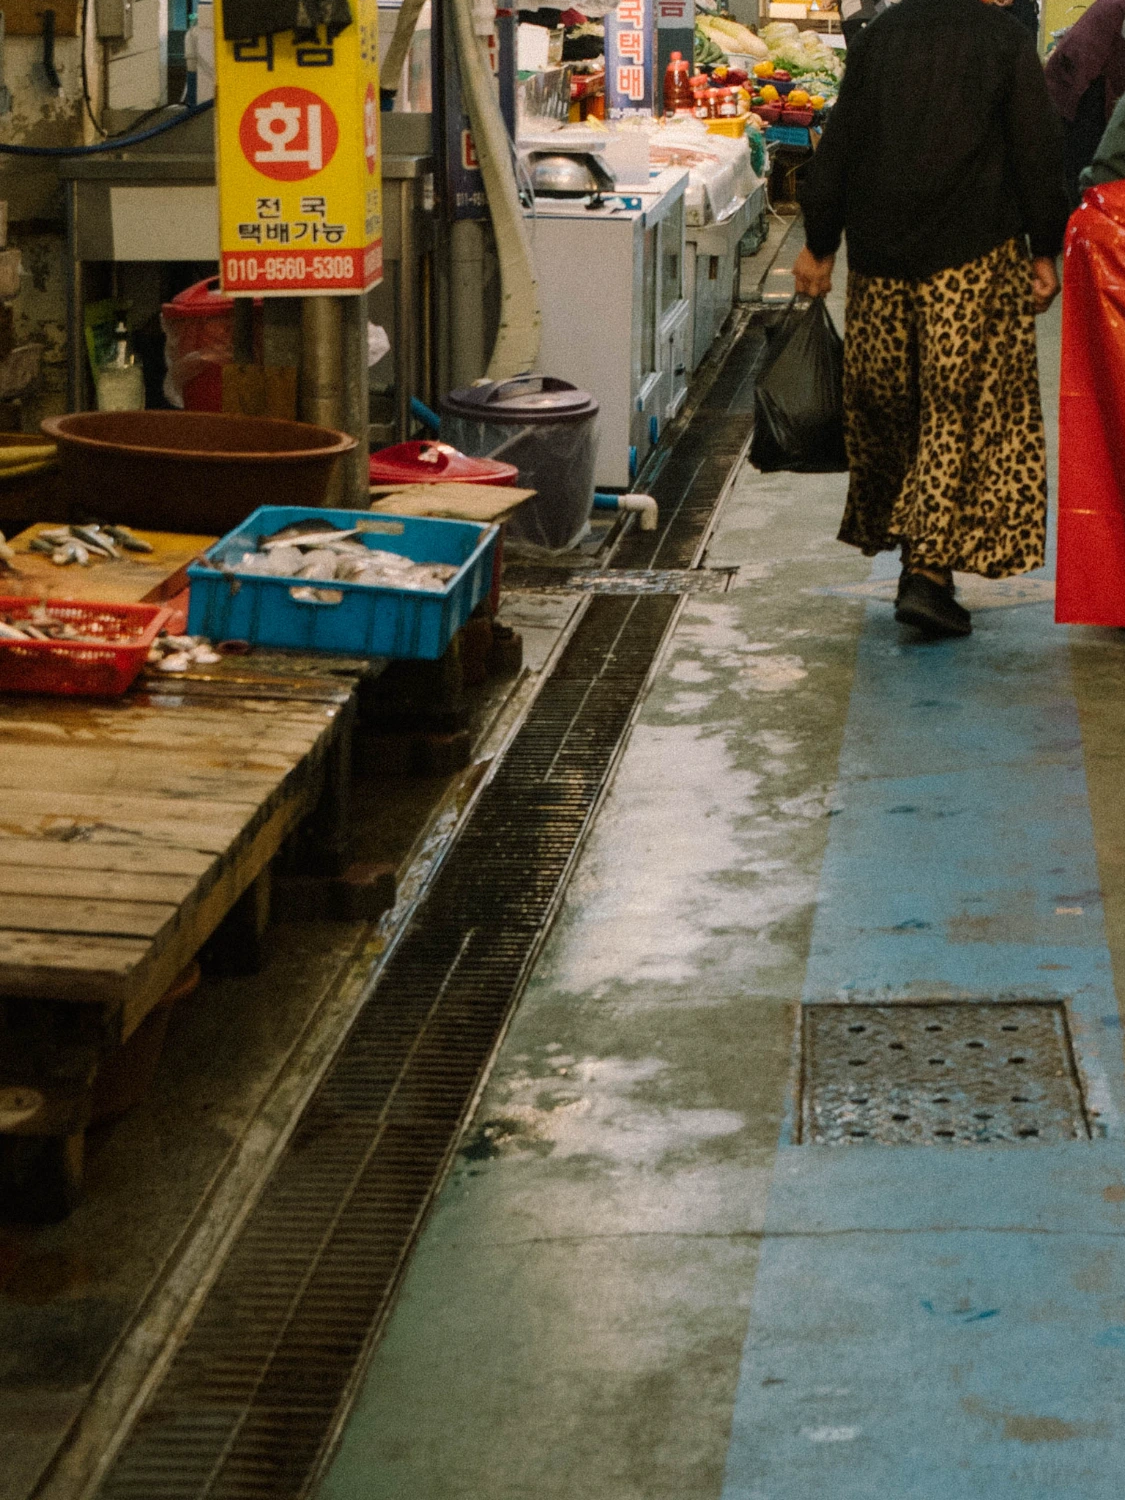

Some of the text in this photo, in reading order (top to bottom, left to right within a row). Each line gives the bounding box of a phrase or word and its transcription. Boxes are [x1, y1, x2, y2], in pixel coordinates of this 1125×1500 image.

[254, 101, 324, 172] 회
[256, 197, 327, 219] 전 국
[237, 221, 348, 244] 택배가능
[227, 255, 354, 283] 010-9560-5308
